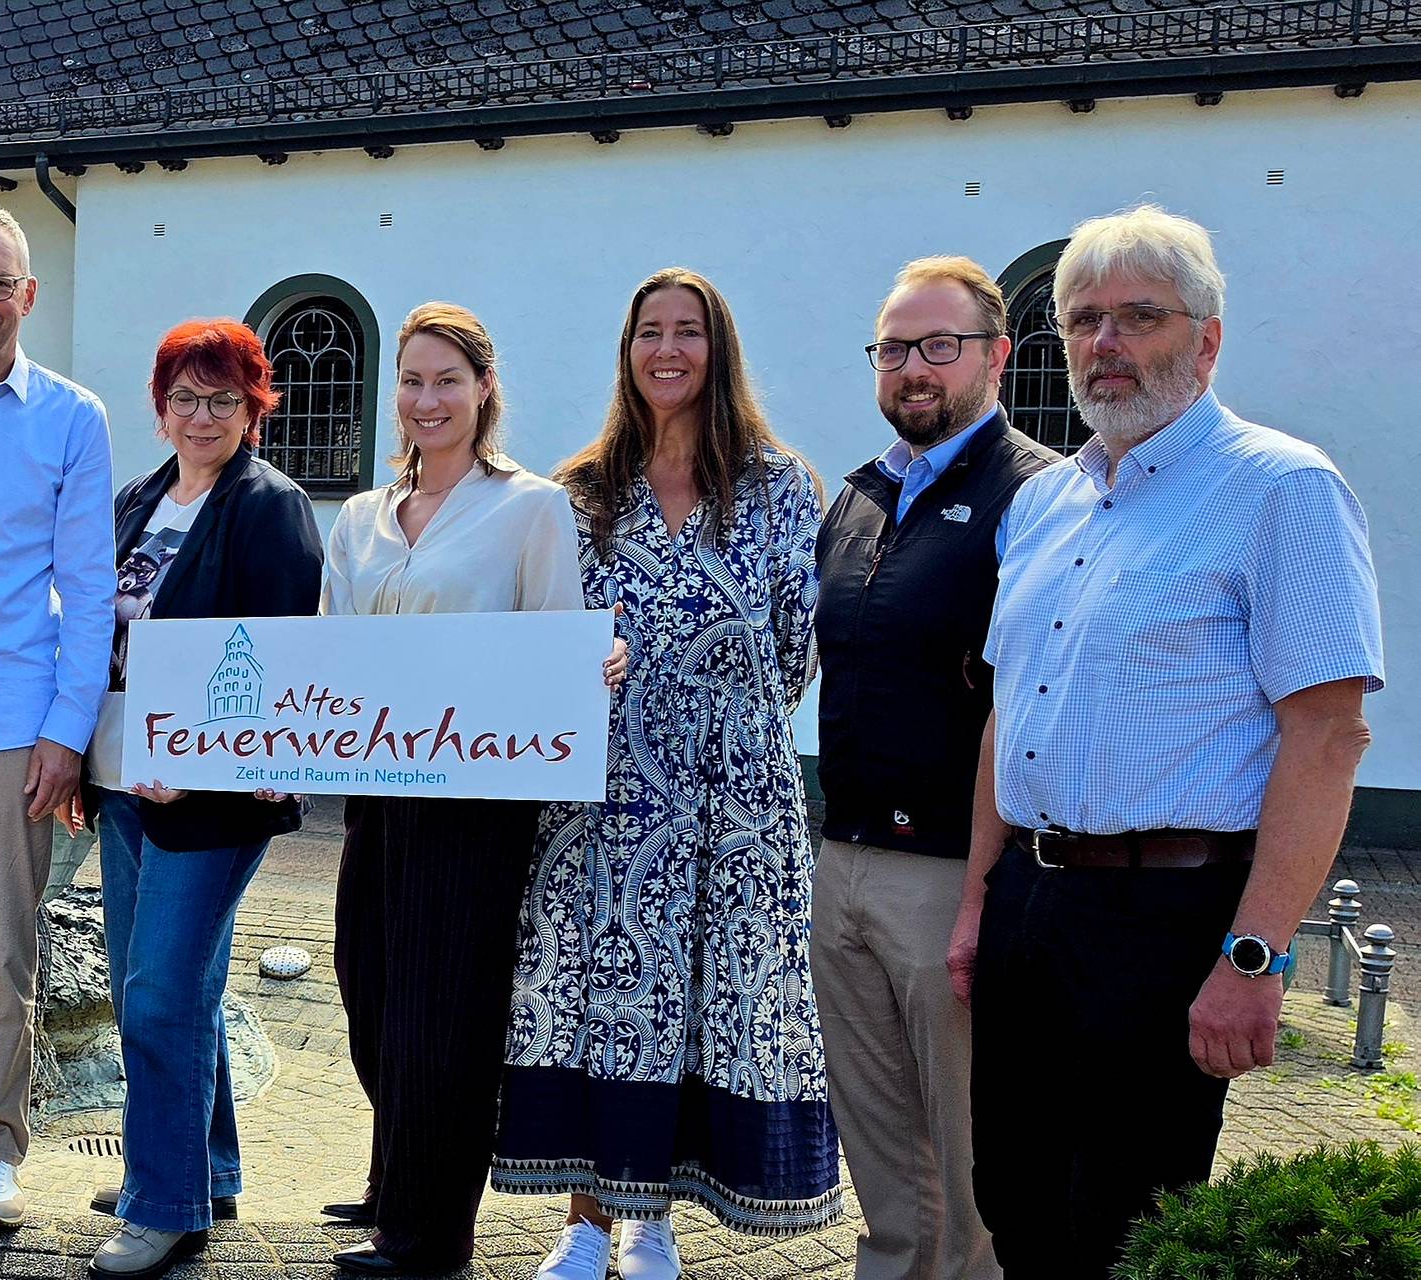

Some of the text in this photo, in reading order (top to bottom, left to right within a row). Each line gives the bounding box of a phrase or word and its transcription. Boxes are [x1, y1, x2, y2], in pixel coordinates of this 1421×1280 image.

[274, 684, 365, 719] Altes
[145, 706, 577, 763] Feuerwehrhaus
[235, 766, 447, 787] Zeit und Raum in Netphen
